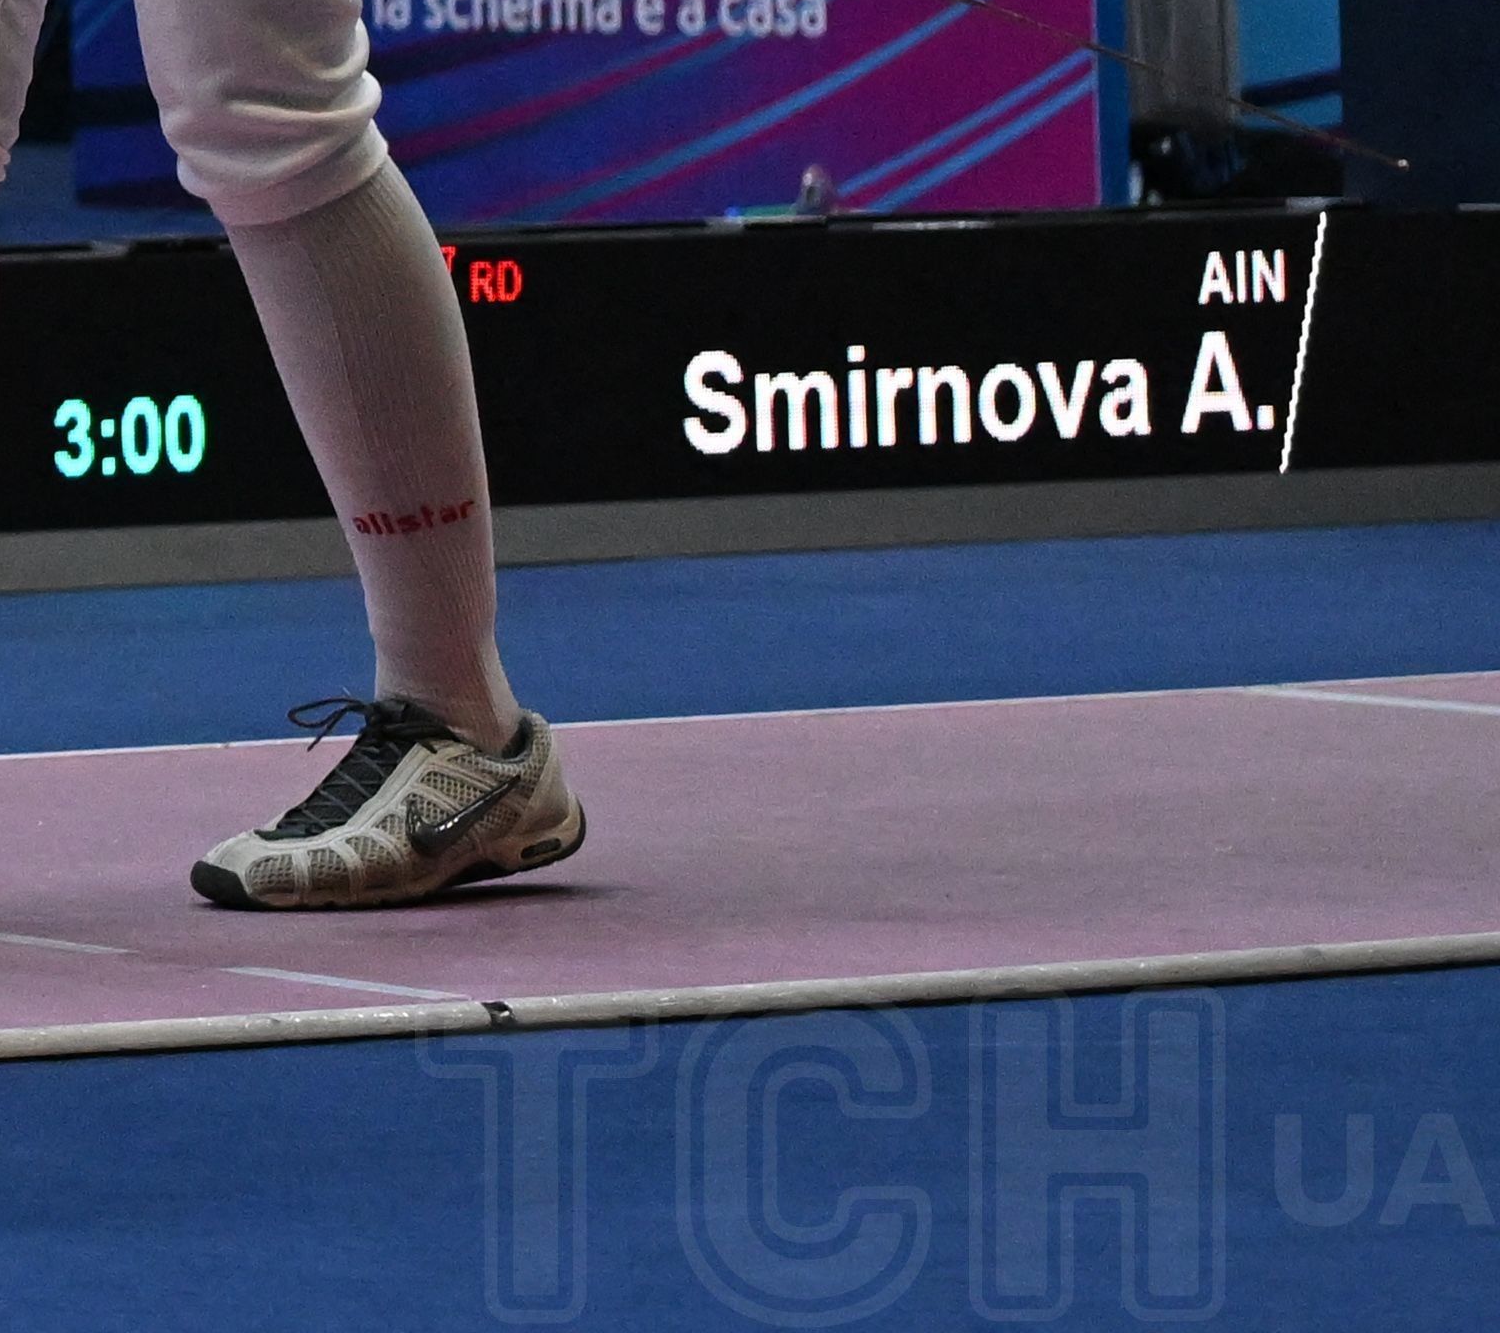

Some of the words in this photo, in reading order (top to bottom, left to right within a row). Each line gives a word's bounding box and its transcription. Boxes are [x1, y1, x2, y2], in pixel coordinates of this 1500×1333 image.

[469, 259, 523, 304] RD
[1199, 249, 1286, 304] AIN
[683, 344, 1152, 454] Smirnova
[1181, 330, 1275, 434] A.
[53, 395, 206, 477] 3:00
[352, 500, 476, 536] allstar
